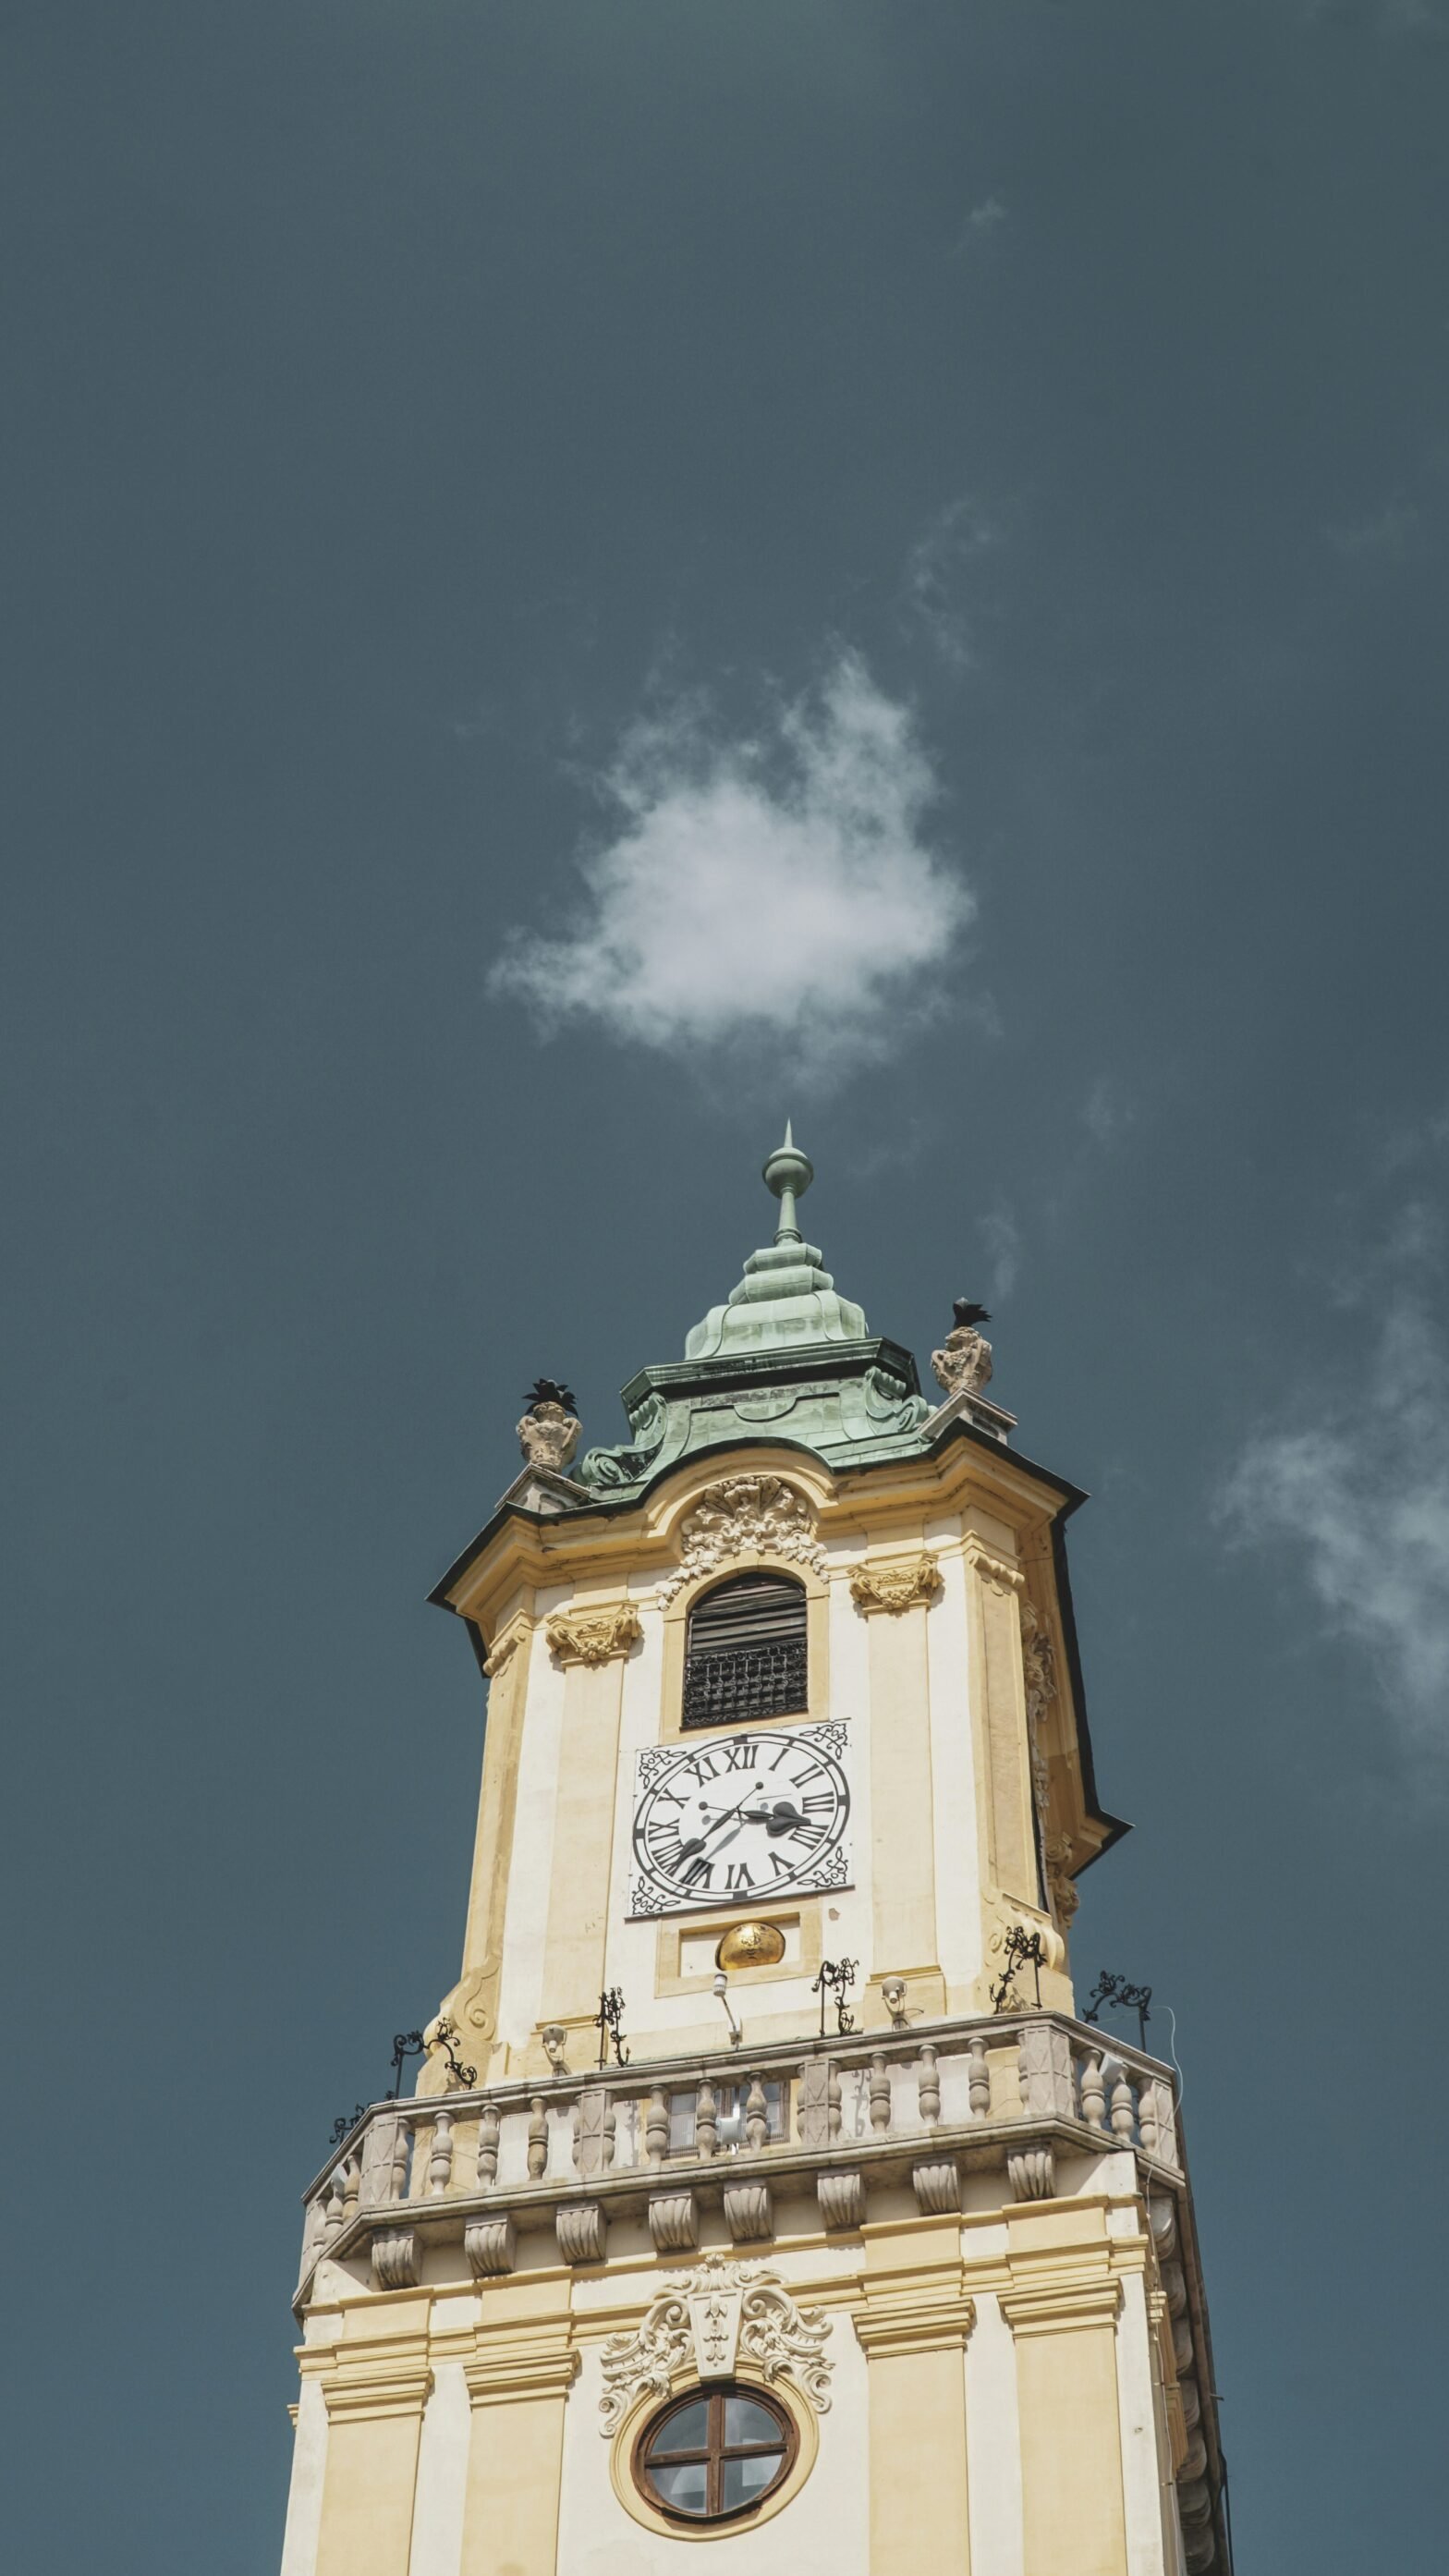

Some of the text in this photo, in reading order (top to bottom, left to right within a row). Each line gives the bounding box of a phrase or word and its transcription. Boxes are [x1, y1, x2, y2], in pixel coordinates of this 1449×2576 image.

[723, 1745, 759, 1773] XII
[768, 1748, 790, 1771] I
[684, 1757, 721, 1788] XI
[789, 1764, 824, 1789] II
[657, 1788, 690, 1809] X
[802, 1791, 834, 1814] III
[649, 1818, 679, 1842] IX
[788, 1825, 829, 1850] IIII
[678, 1858, 715, 1888] VII
[724, 1862, 755, 1889] VI
[768, 1851, 796, 1876] V
